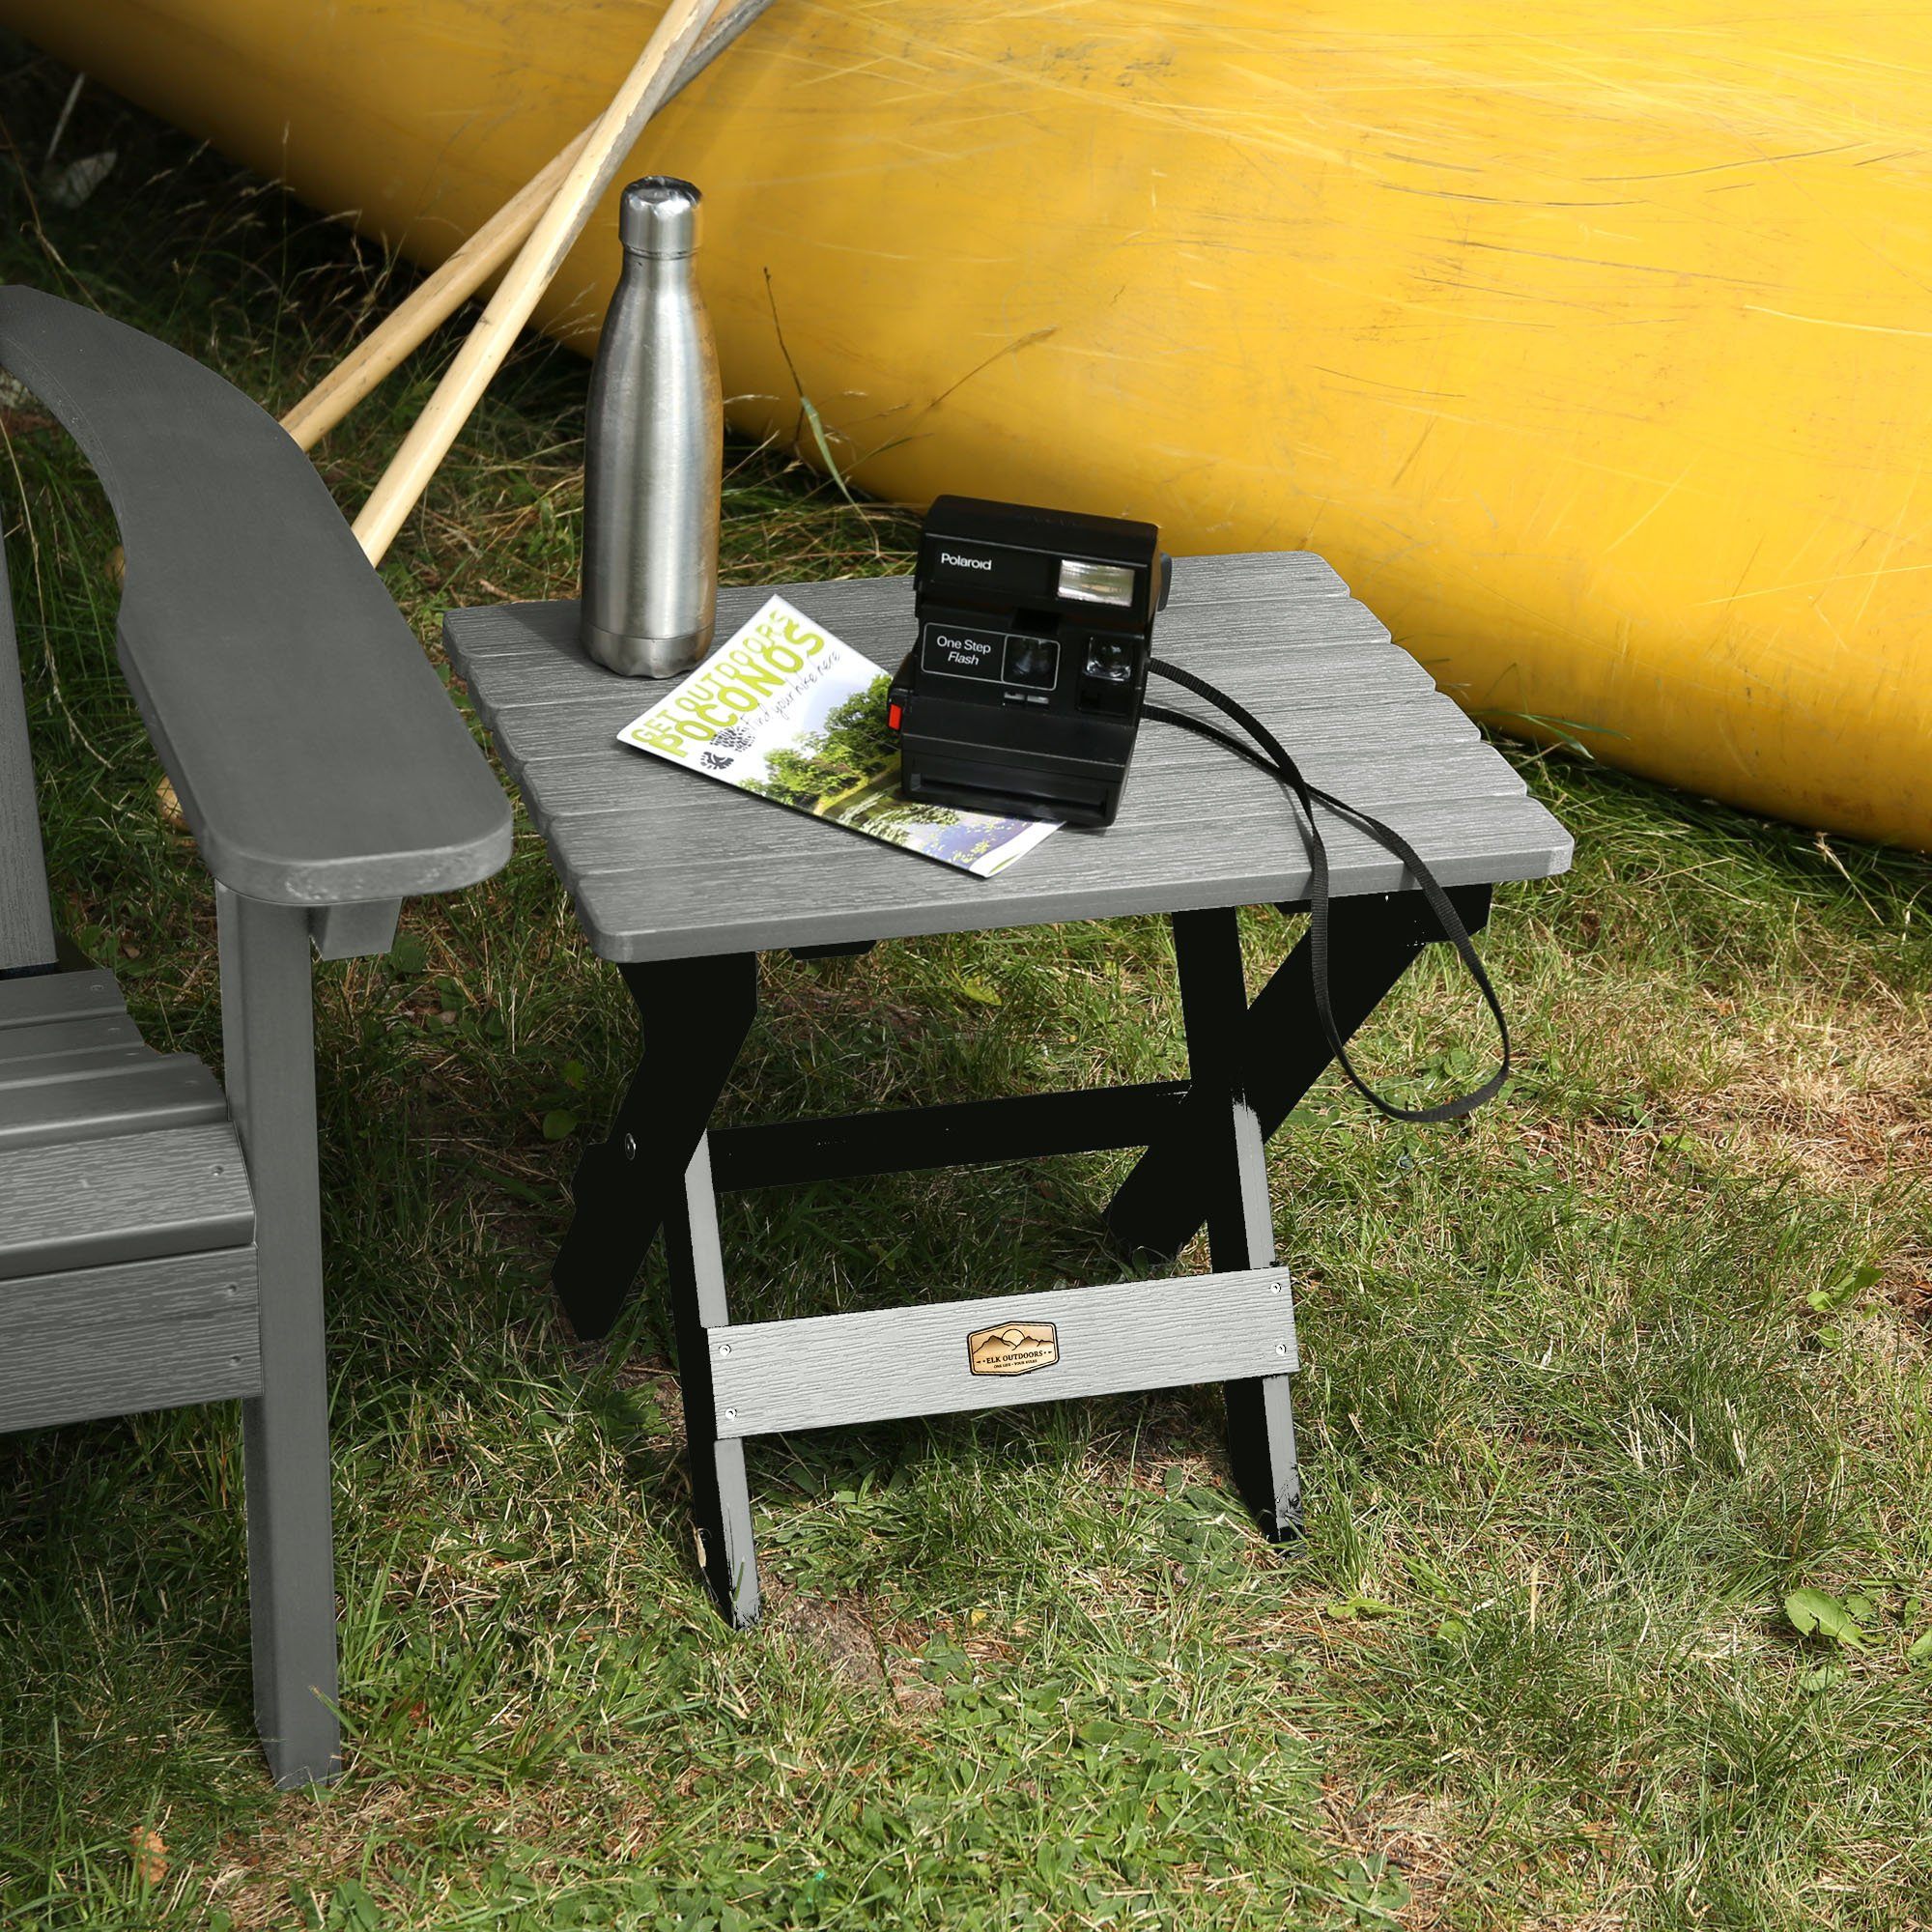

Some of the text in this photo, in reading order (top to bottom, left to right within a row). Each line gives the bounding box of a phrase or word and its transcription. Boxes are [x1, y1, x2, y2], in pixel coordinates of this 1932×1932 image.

[941, 552, 992, 571] Polaroid
[936, 635, 991, 654] One Step
[948, 650, 980, 665] Flash
[631, 609, 793, 743] GET OUTDOORS
[647, 620, 825, 758] POCONOS
[740, 650, 840, 731] Find your hike here
[1003, 1350, 1043, 1361] OUTDOORS
